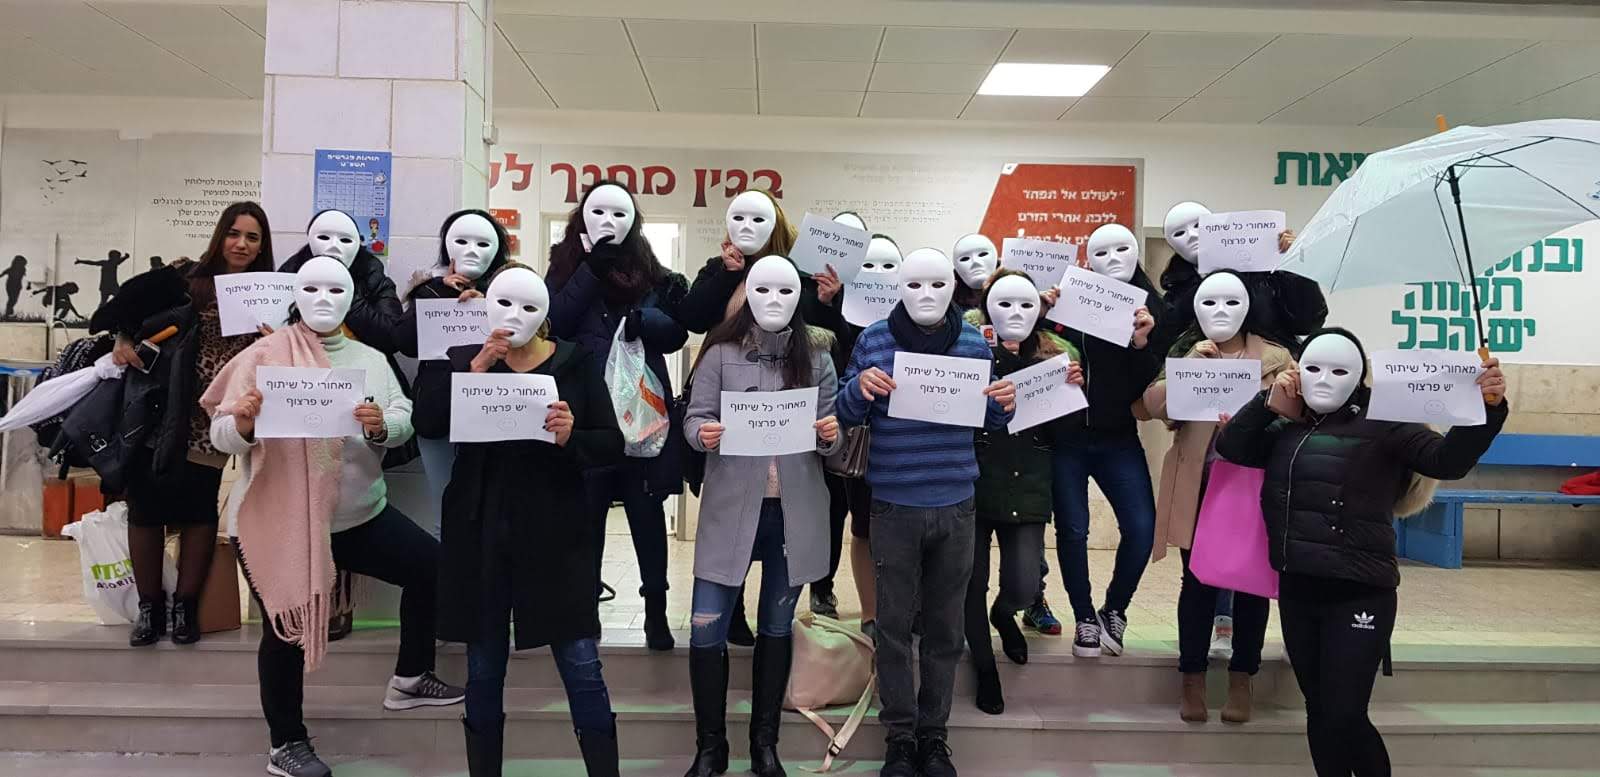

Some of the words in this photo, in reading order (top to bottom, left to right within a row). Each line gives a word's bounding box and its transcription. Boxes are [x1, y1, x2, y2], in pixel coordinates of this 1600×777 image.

[550, 162, 677, 203] מחנך
[692, 169, 784, 207] בגין
[1060, 188, 1077, 200] אל
[1017, 212, 1049, 222] הזרם
[1052, 213, 1081, 222] אחרי
[1085, 212, 1117, 223] ללכת
[1205, 223, 1230, 233] שיתוף
[1232, 222, 1243, 230] כל
[809, 226, 831, 239] שיתוף
[832, 231, 841, 242] כל
[842, 237, 864, 249] מאחורי
[1220, 237, 1246, 247] פרצוף
[817, 244, 838, 256] פרצוף
[839, 250, 848, 258] יש
[1010, 248, 1032, 258] שיתוף
[1035, 250, 1044, 258] כל
[1046, 253, 1070, 261] מאחורי
[1023, 263, 1045, 272] פרצוף
[253, 283, 265, 291] כל
[850, 281, 873, 290] שיתוף
[875, 282, 883, 290] כל
[1069, 276, 1094, 290] שיתוף
[224, 284, 252, 295] שיתוף
[1095, 284, 1105, 294] כל
[864, 295, 886, 305] פרצוף
[1078, 295, 1102, 308] פרצוף
[1107, 291, 1135, 305] מאחורי
[1404, 276, 1523, 318] תקווה
[242, 297, 270, 308] פרצוף
[453, 309, 464, 317] כל
[1104, 304, 1114, 312] יש
[424, 311, 451, 319] שיתוף
[465, 310, 489, 318] אחורי
[442, 325, 467, 333] פרצוף
[1391, 310, 1476, 352] הכל
[1487, 318, 1536, 352] יש
[904, 365, 932, 377] שיתוף
[1385, 363, 1419, 374] שיתוף
[1423, 362, 1437, 373] כל
[1440, 364, 1477, 374] מאחורי
[934, 368, 945, 378] כל
[948, 371, 980, 381] מאחורי
[1043, 365, 1067, 381] מאחורי
[1175, 370, 1202, 380] שיתוף
[1205, 369, 1216, 379] כל
[1219, 372, 1251, 380] מאחורי
[301, 379, 314, 389] כל
[1033, 374, 1043, 384] כל
[266, 380, 298, 391] שיתוף
[317, 380, 352, 390] מאחורי
[919, 383, 947, 394] פרצוף
[1016, 379, 1032, 390] שיתו
[1045, 383, 1055, 393] יש
[1407, 382, 1441, 393] פרצוף
[1443, 383, 1454, 391] יש
[462, 386, 493, 397] שיתוף
[496, 385, 509, 396] כל
[512, 387, 547, 396] מאחורי
[949, 387, 961, 395] יש
[1024, 387, 1044, 401] פרצוף
[1192, 386, 1220, 395] פרצוף
[1222, 386, 1234, 394] יש
[286, 397, 317, 408] פרצוף
[320, 399, 333, 407] יש
[730, 402, 759, 413] שיתוף
[762, 402, 773, 412] כל
[776, 400, 807, 410] מאחורי
[481, 403, 512, 414] פרצוף
[515, 404, 527, 412] יש
[748, 419, 776, 429] פרצוף
[779, 418, 790, 426] יש
